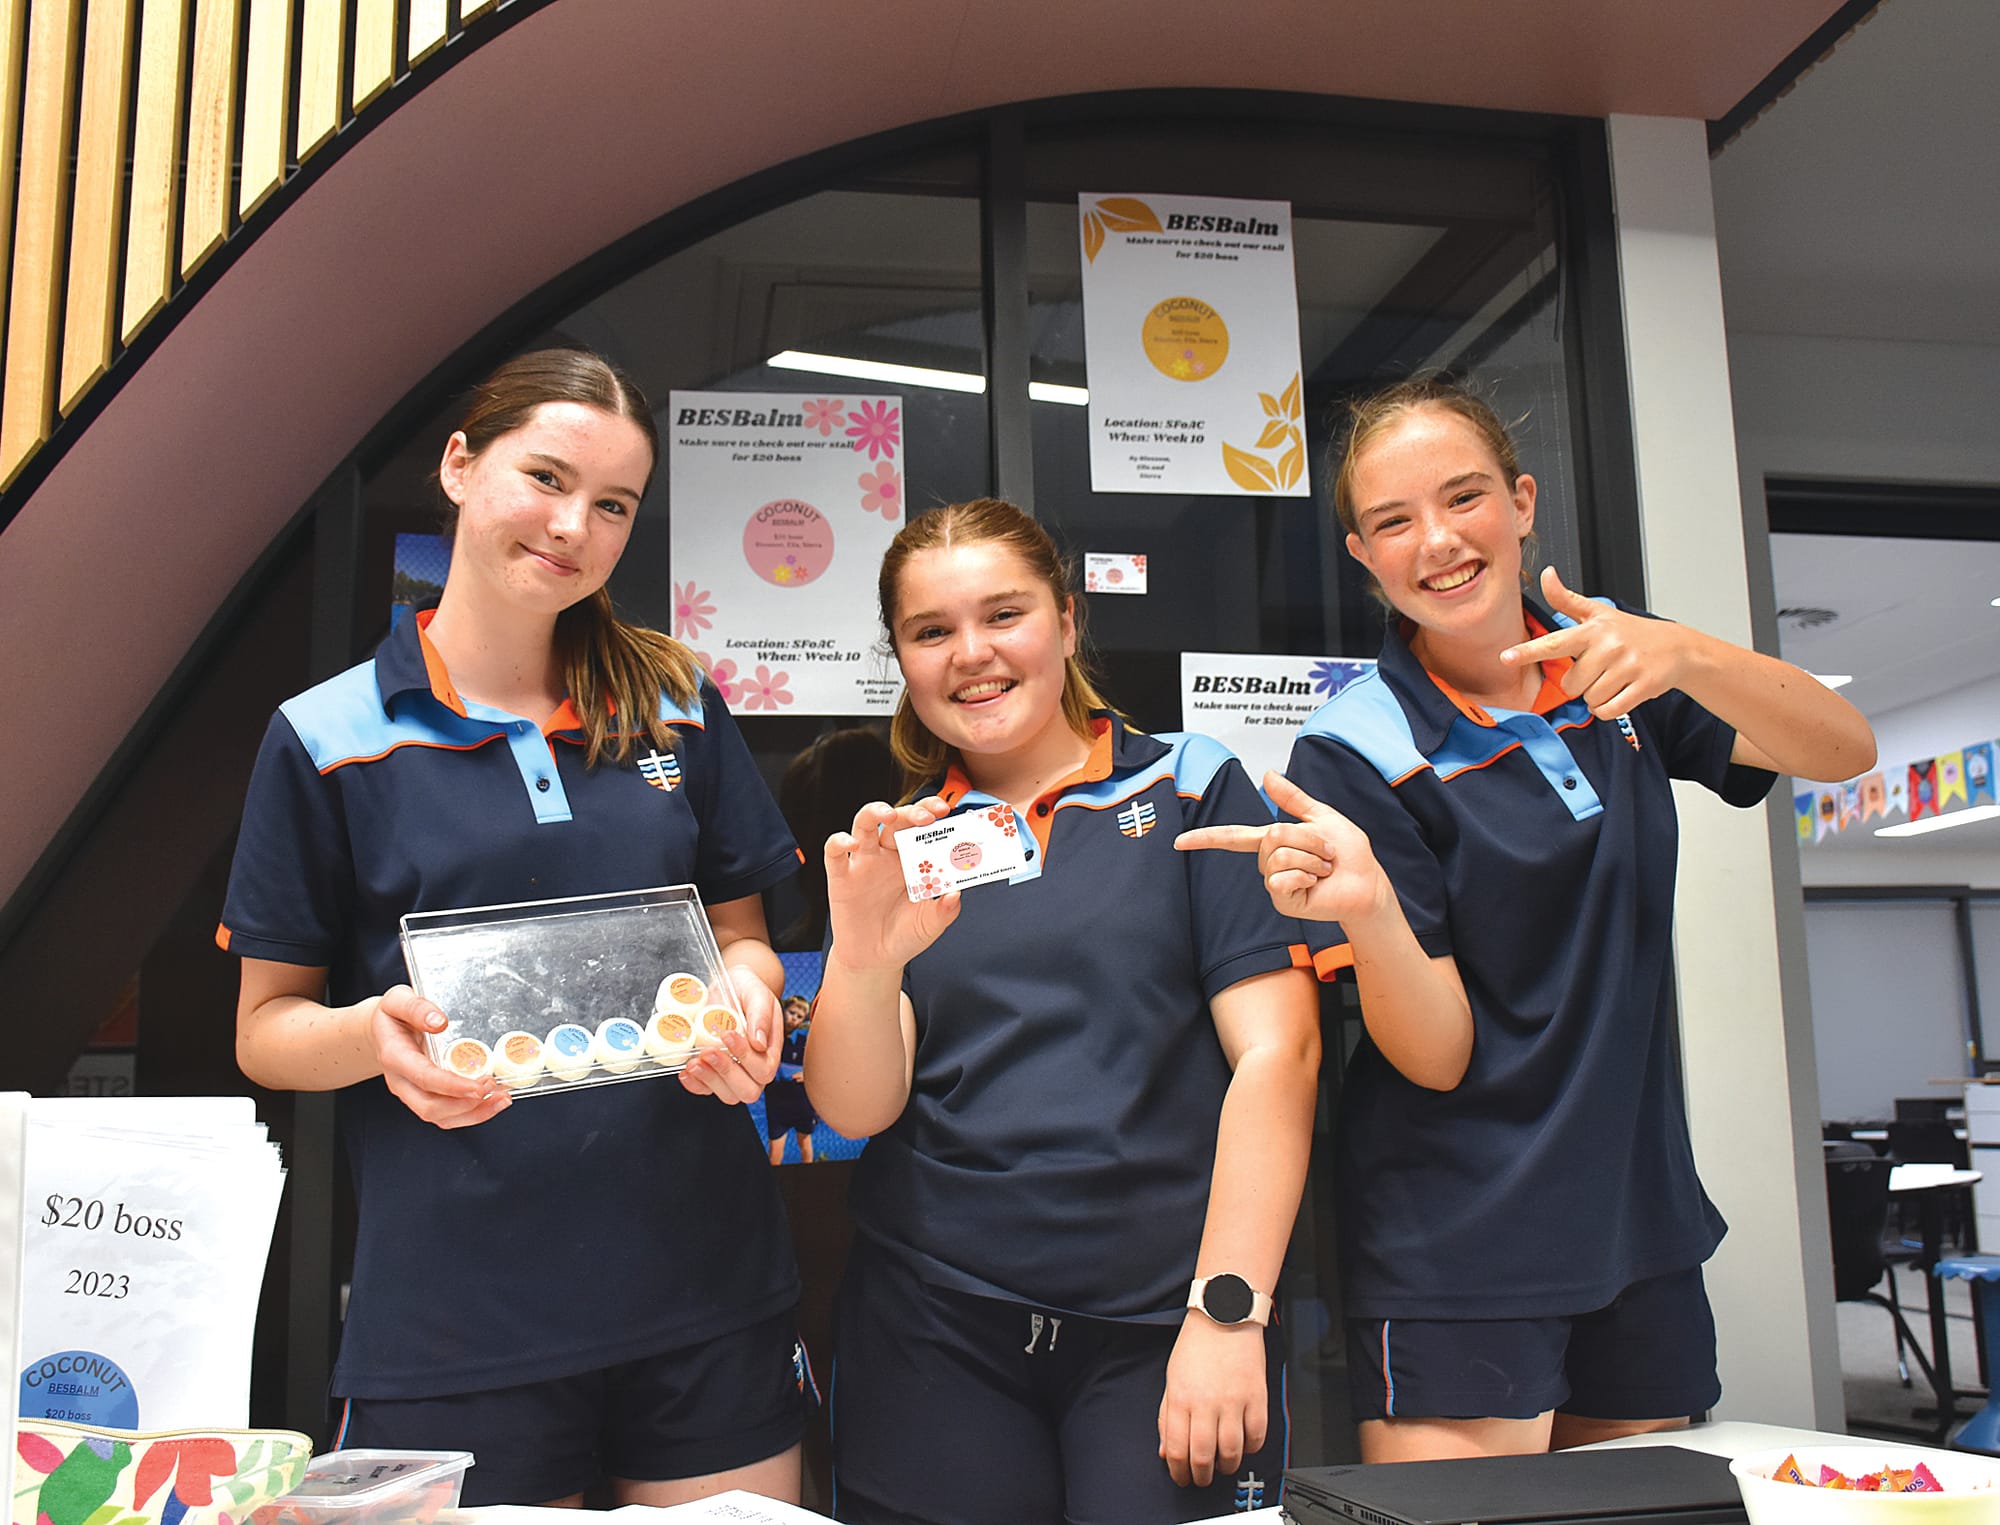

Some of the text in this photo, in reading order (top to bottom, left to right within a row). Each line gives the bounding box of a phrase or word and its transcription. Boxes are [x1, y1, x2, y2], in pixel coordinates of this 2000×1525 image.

[1166, 214, 1279, 236] BESBalm
[1126, 236, 1285, 251] Make sure to check out our stall
[1176, 250, 1239, 261] for $20 boss
[1152, 299, 1216, 319] COCONUT
[676, 408, 803, 427] BESBalm
[1104, 418, 1205, 429] Location: SFoAC
[678, 438, 856, 449] Make sure to check out our stall
[1109, 432, 1205, 444] When: Week 10
[732, 452, 802, 462] for $20 boss
[756, 502, 820, 523] COCONUT
[726, 638, 836, 649] Location: SFoAC
[757, 651, 862, 662] When: Week 10
[1192, 675, 1311, 695] BESBalm
[1193, 701, 1222, 710] Make
[1224, 702, 1249, 711] sure
[1250, 702, 1262, 711] to
[1263, 702, 1293, 712] check
[1295, 703, 1312, 712] out
[1244, 716, 1260, 725] for
[1263, 716, 1283, 725] $20
[915, 826, 955, 842] BESBalm
[41, 1193, 183, 1241] $20 boss
[64, 1269, 130, 1299] 2023
[26, 1356, 126, 1392] COCONUT
[48, 1383, 100, 1396] BESBALM
[45, 1408, 92, 1421] $20 boss
